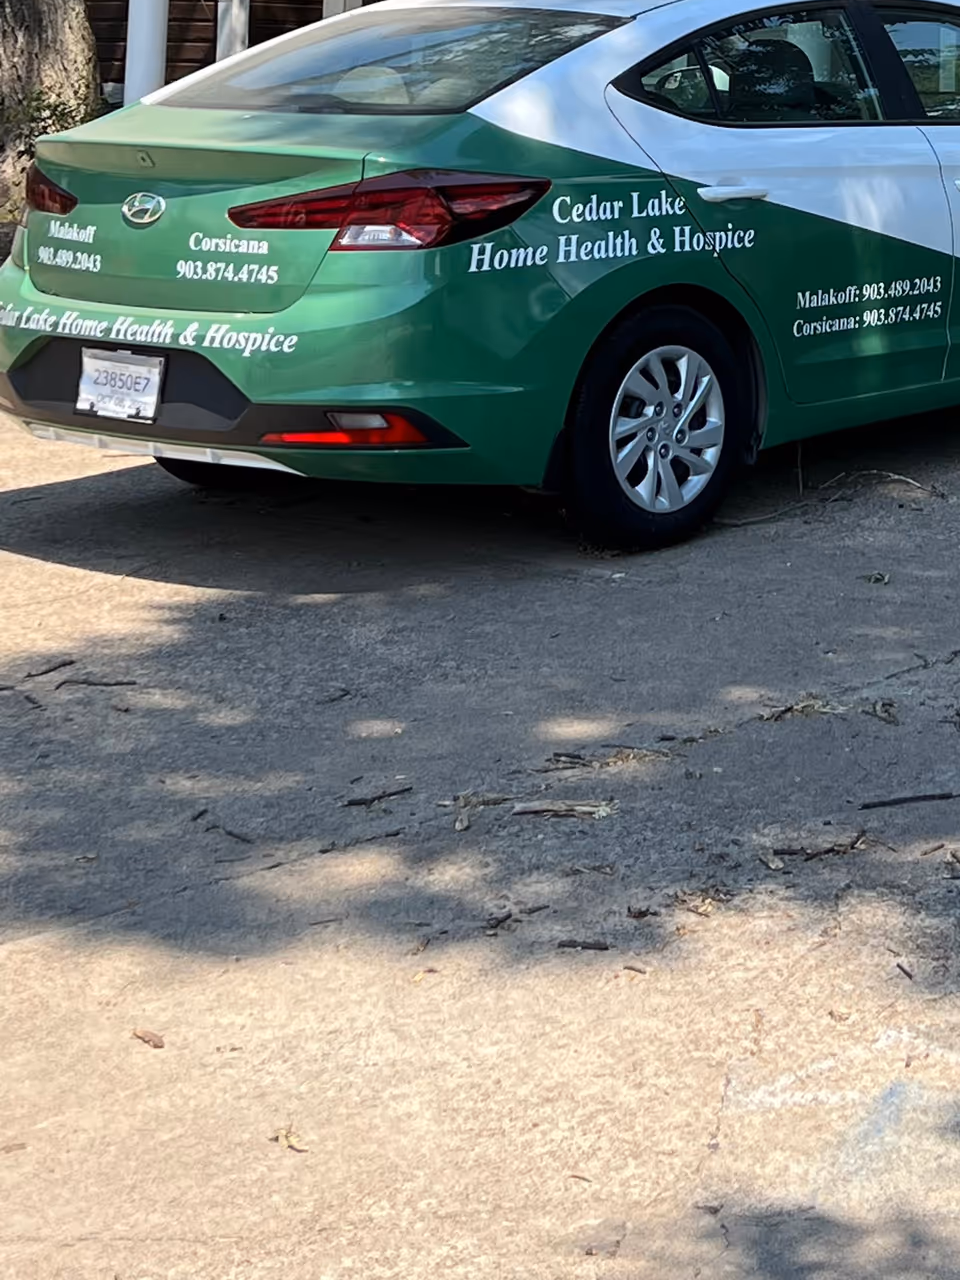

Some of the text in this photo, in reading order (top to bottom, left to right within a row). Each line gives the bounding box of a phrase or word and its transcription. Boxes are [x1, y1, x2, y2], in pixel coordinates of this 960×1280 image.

[552, 189, 686, 224] Cedar Lake
[48, 220, 97, 244] Malakoff
[188, 232, 269, 255] Corsicana
[37, 246, 102, 272] 903.489.2043
[467, 223, 755, 273] Home Health & Hospice
[176, 259, 279, 284] 903.874.4745
[796, 275, 942, 310] Malakoff: 903.489.2043
[20, 306, 57, 332] Lake
[56, 311, 108, 337] Home
[109, 315, 174, 344] Health
[178, 321, 200, 346] &
[202, 323, 299, 357] Hospice
[792, 301, 943, 338] Corsicana: 903.874.4745
[93, 368, 151, 393] 23850E7
